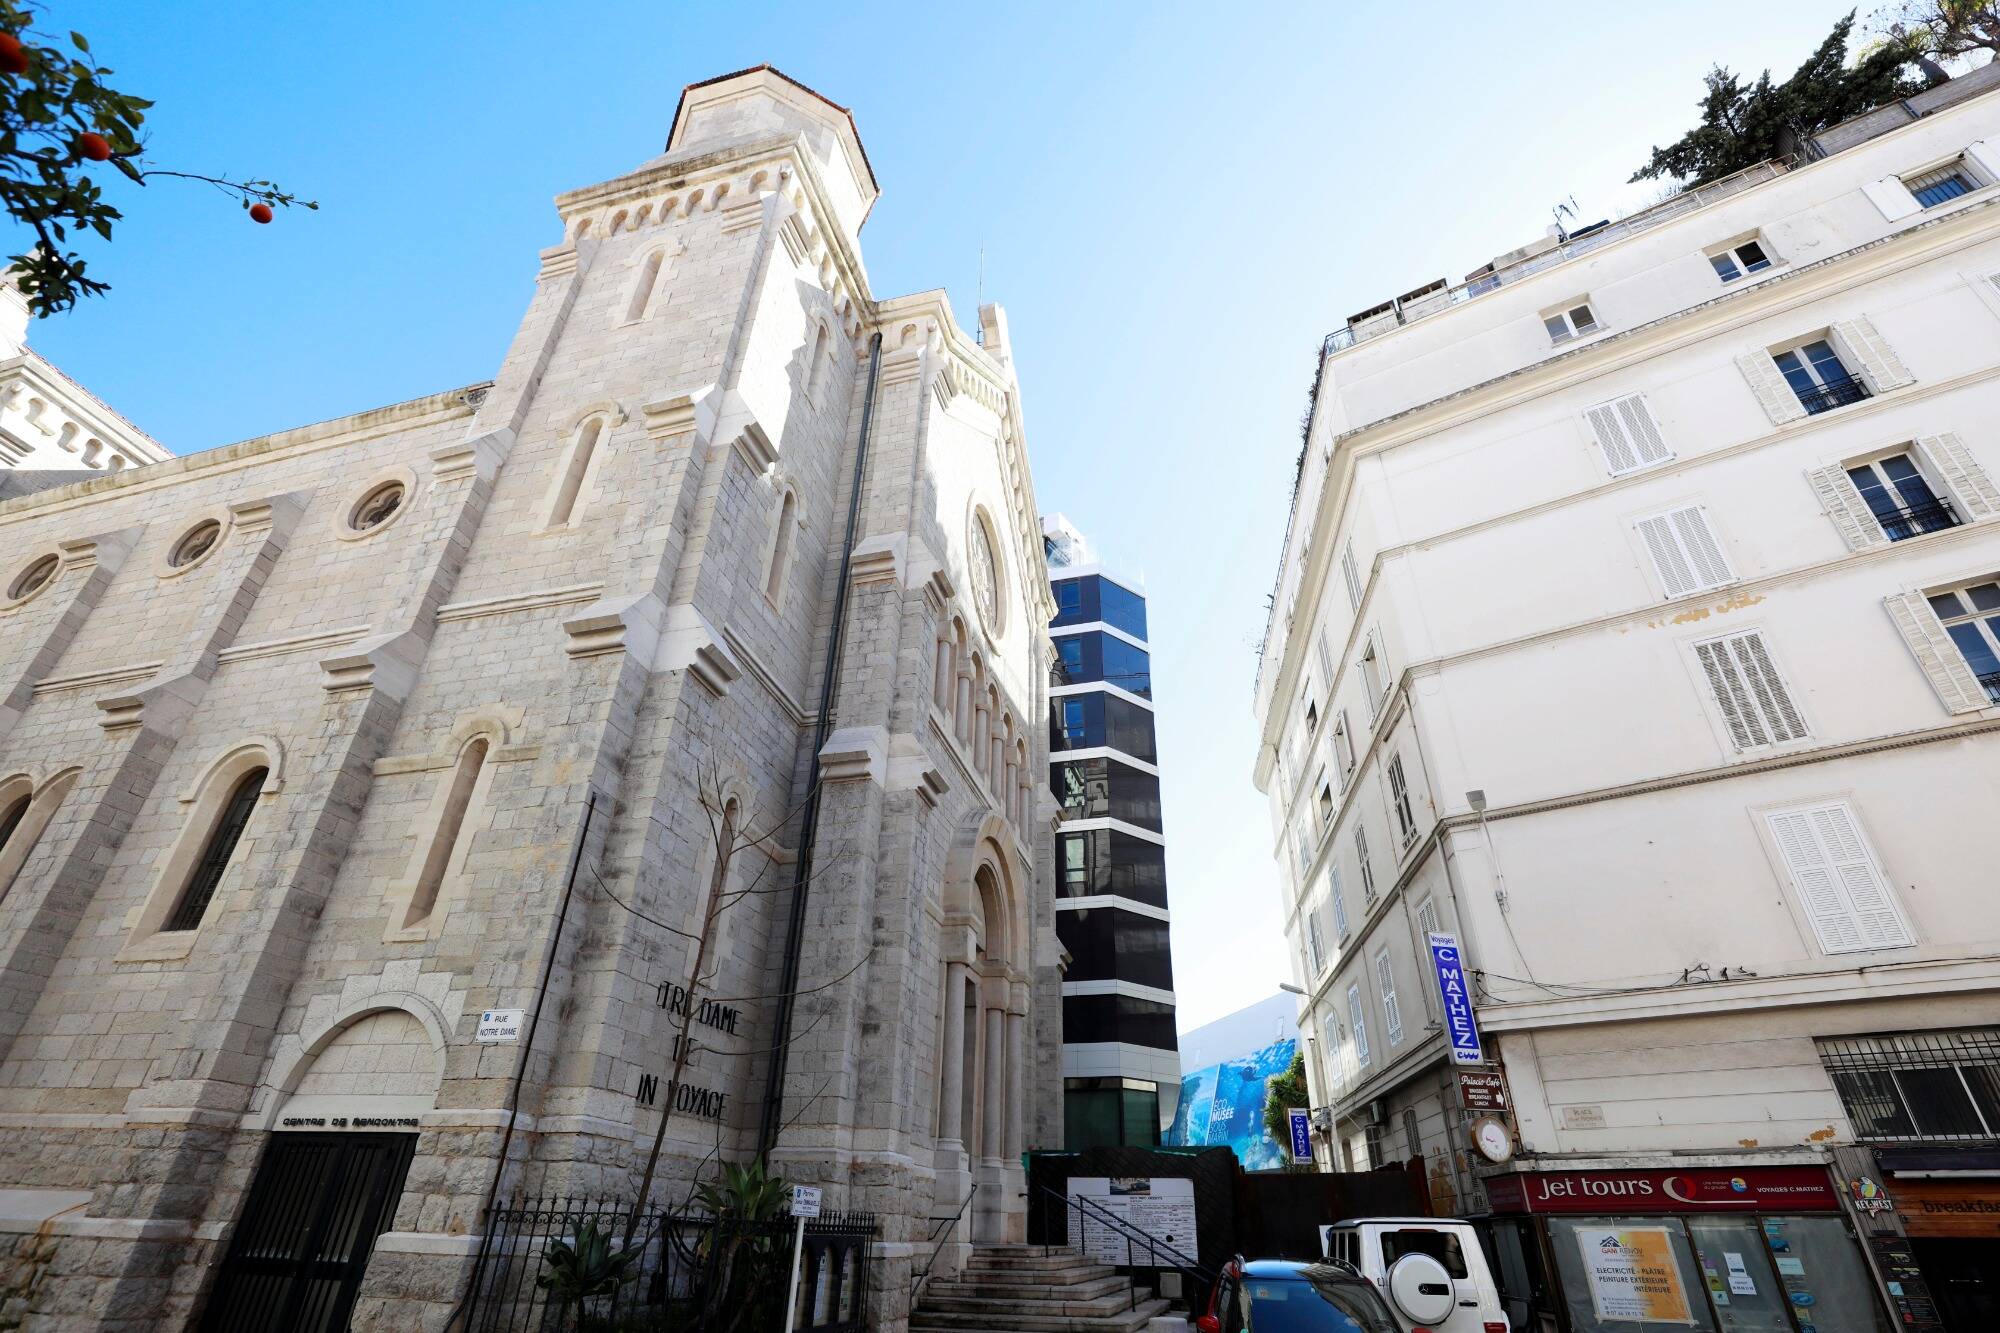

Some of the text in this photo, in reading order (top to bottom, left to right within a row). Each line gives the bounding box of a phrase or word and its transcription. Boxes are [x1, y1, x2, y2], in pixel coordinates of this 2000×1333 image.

[1431, 935, 1455, 945] Voyages
[1441, 967, 1473, 1047] MATHEZ
[494, 1015, 508, 1023] RUE
[699, 997, 742, 1037] DAME
[480, 1027, 517, 1037] NOTRE DAME
[1460, 1075, 1500, 1089] Palacio Café
[1538, 1177, 1653, 1200] Jet tours
